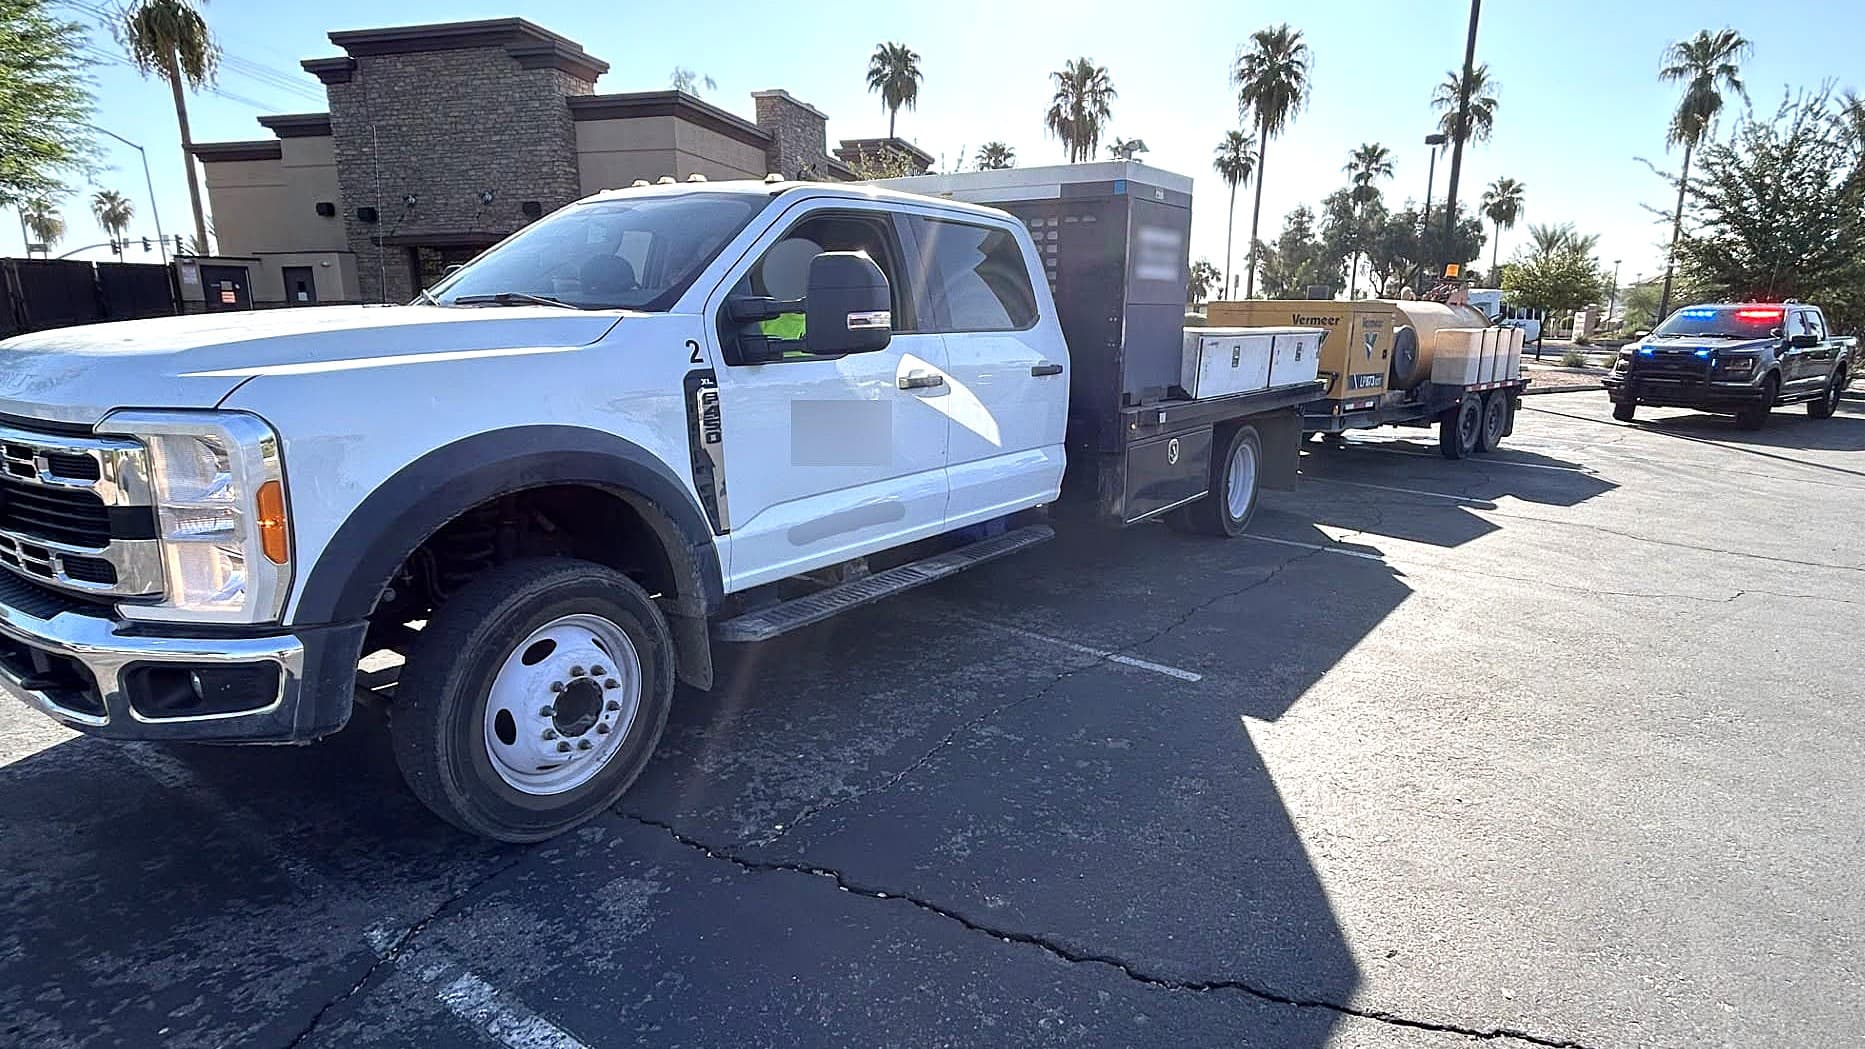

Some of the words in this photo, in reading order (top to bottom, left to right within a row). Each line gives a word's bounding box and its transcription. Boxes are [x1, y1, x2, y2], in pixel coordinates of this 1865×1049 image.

[1292, 313, 1341, 326] Vermeer
[685, 339, 704, 364] 2
[702, 392, 722, 444] F450
